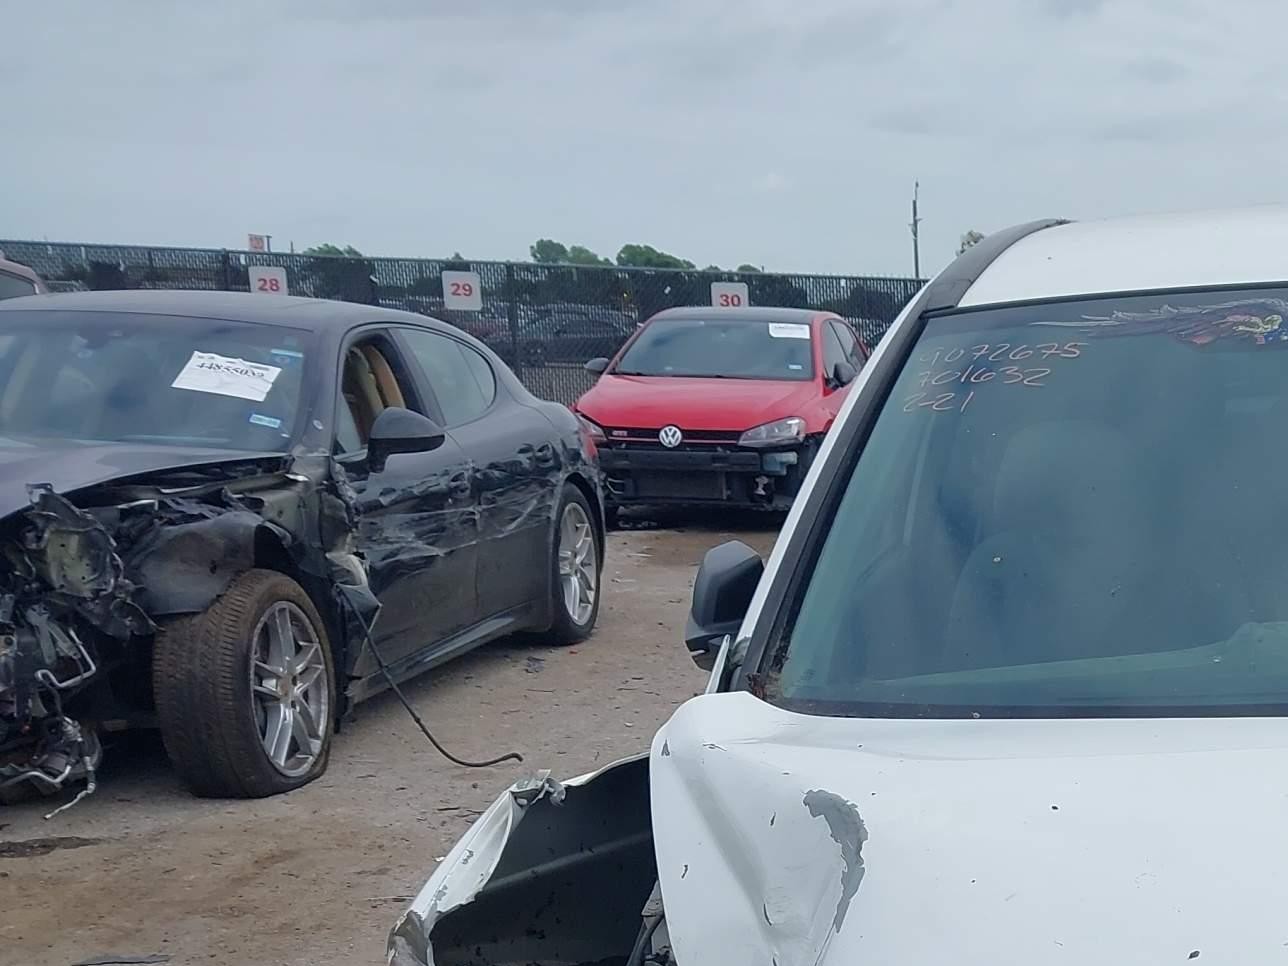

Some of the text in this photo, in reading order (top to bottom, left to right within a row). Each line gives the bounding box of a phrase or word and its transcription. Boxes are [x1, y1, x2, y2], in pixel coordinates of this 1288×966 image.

[257, 278, 280, 292] 28
[450, 282, 473, 297] 29
[720, 294, 741, 307] 30
